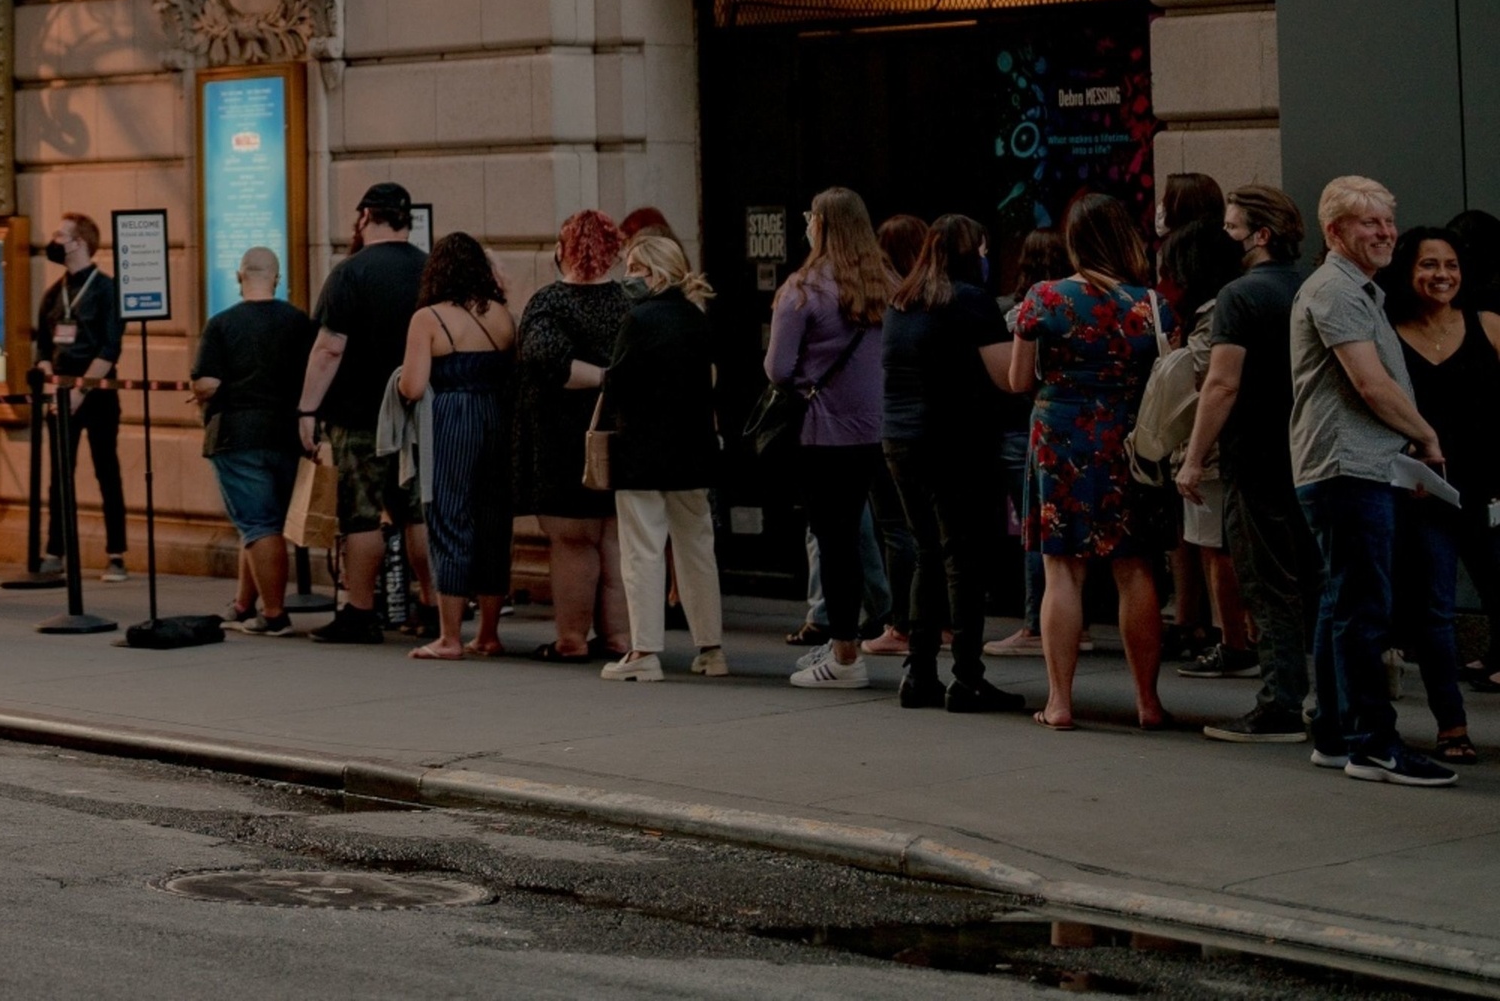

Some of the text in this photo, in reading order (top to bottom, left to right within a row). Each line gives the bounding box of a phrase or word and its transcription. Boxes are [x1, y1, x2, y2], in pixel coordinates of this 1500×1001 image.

[1058, 86, 1121, 106] Debra MESSING
[121, 220, 160, 229] WELCOME
[749, 213, 784, 234] STAGE
[749, 234, 784, 258] DOOR
